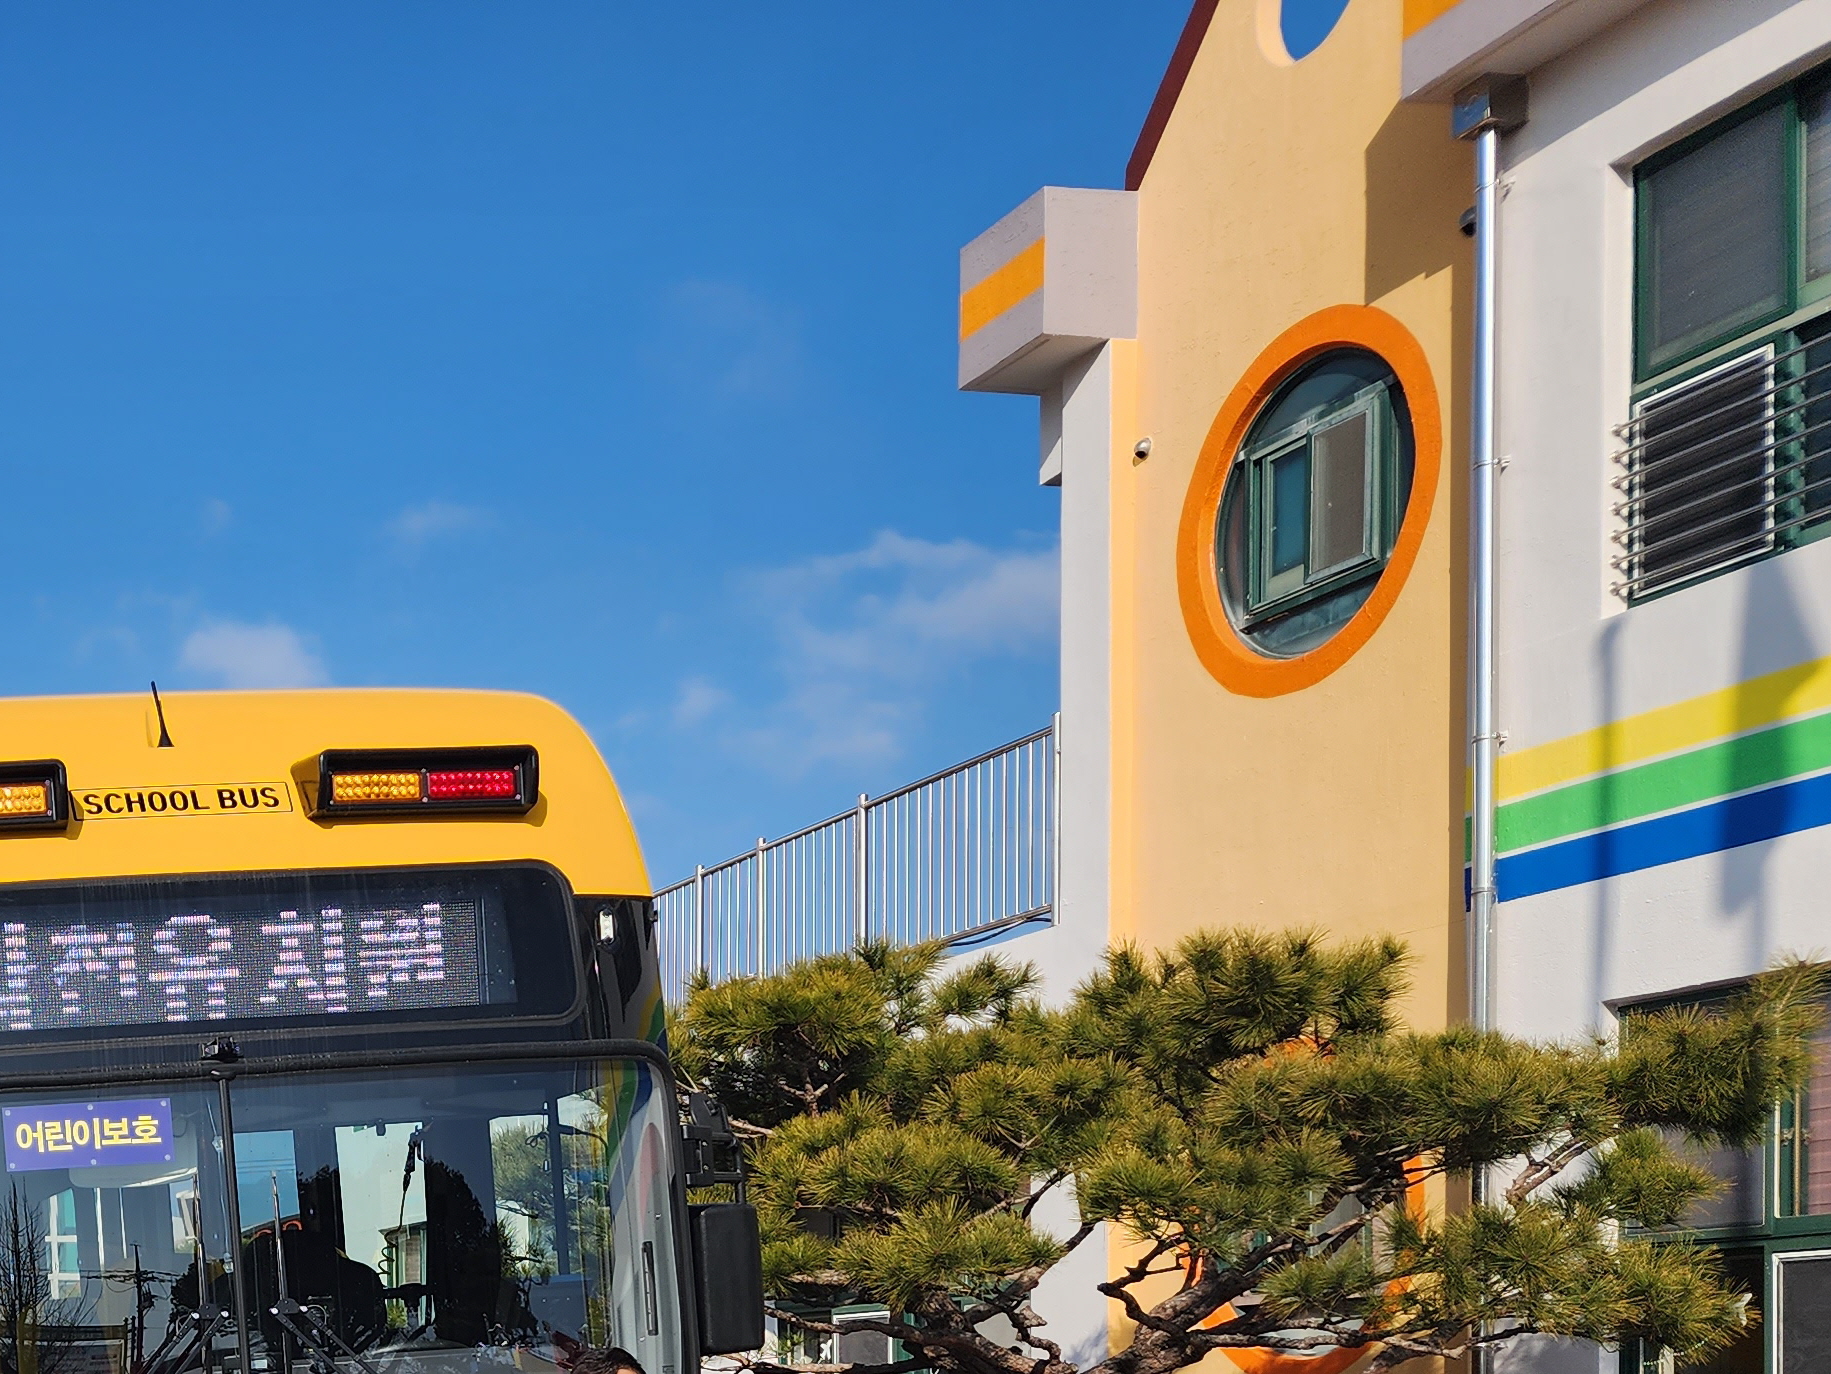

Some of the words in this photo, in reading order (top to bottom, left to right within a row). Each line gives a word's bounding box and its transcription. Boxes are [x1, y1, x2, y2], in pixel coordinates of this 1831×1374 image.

[83, 788, 210, 815] SCHOOL
[217, 786, 280, 810] BUS
[15, 1114, 163, 1153] 어린이보호
